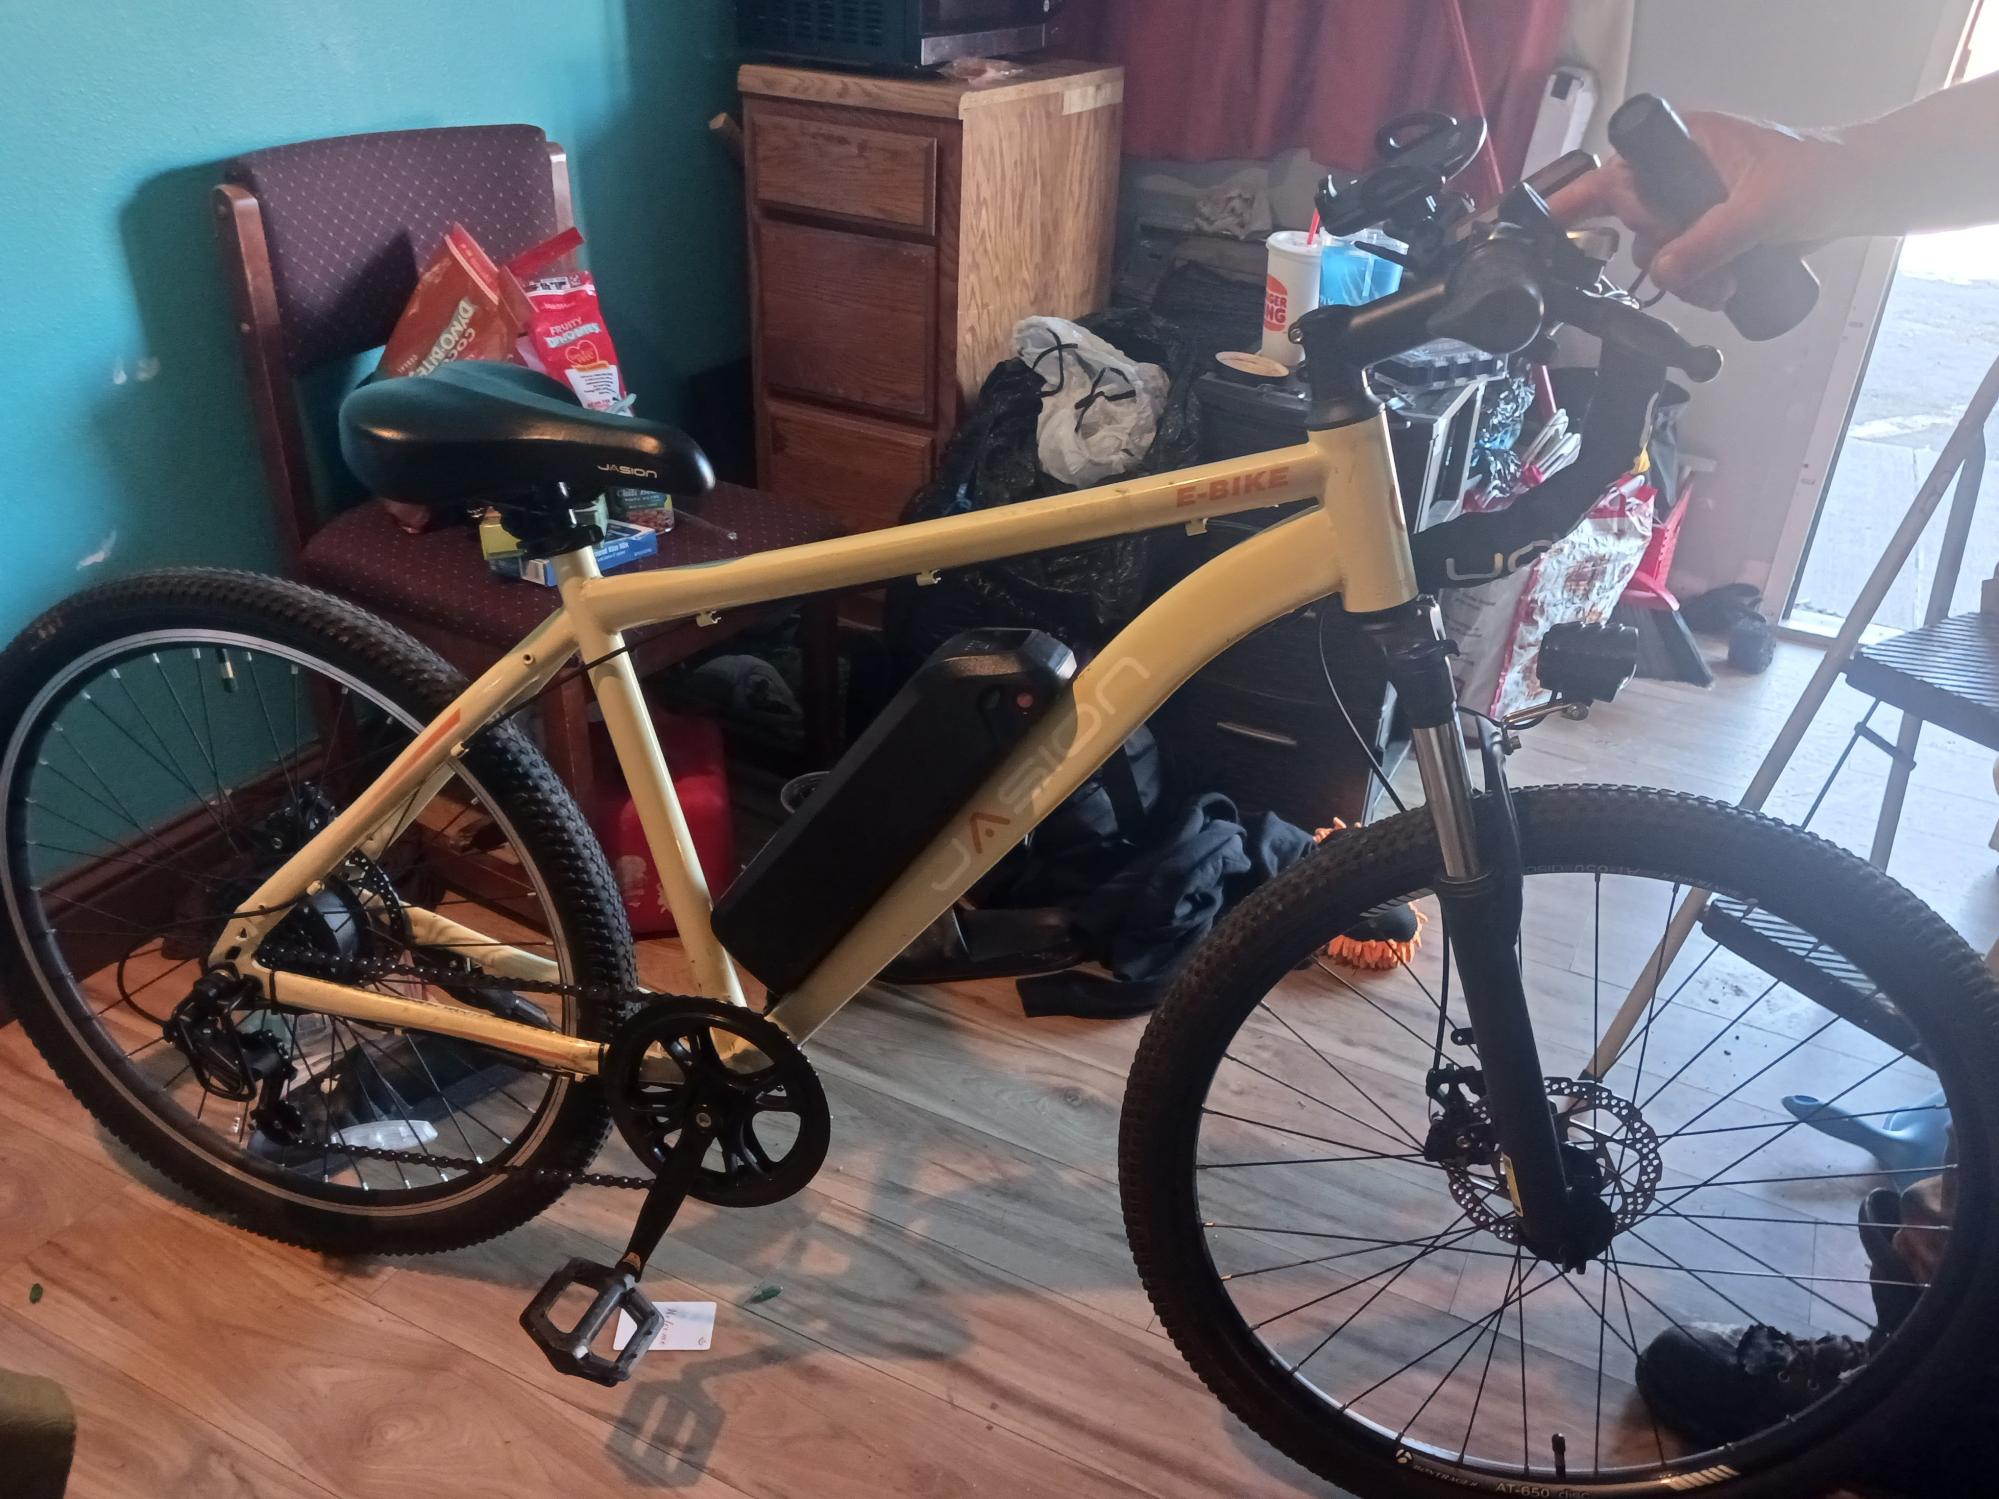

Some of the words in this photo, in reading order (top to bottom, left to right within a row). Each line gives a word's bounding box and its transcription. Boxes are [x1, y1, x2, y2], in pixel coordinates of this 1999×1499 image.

[549, 316, 582, 336] FRUITY
[597, 463, 658, 479] JASION
[1176, 466, 1289, 508] E-BIKE
[931, 656, 1150, 891] JASION
